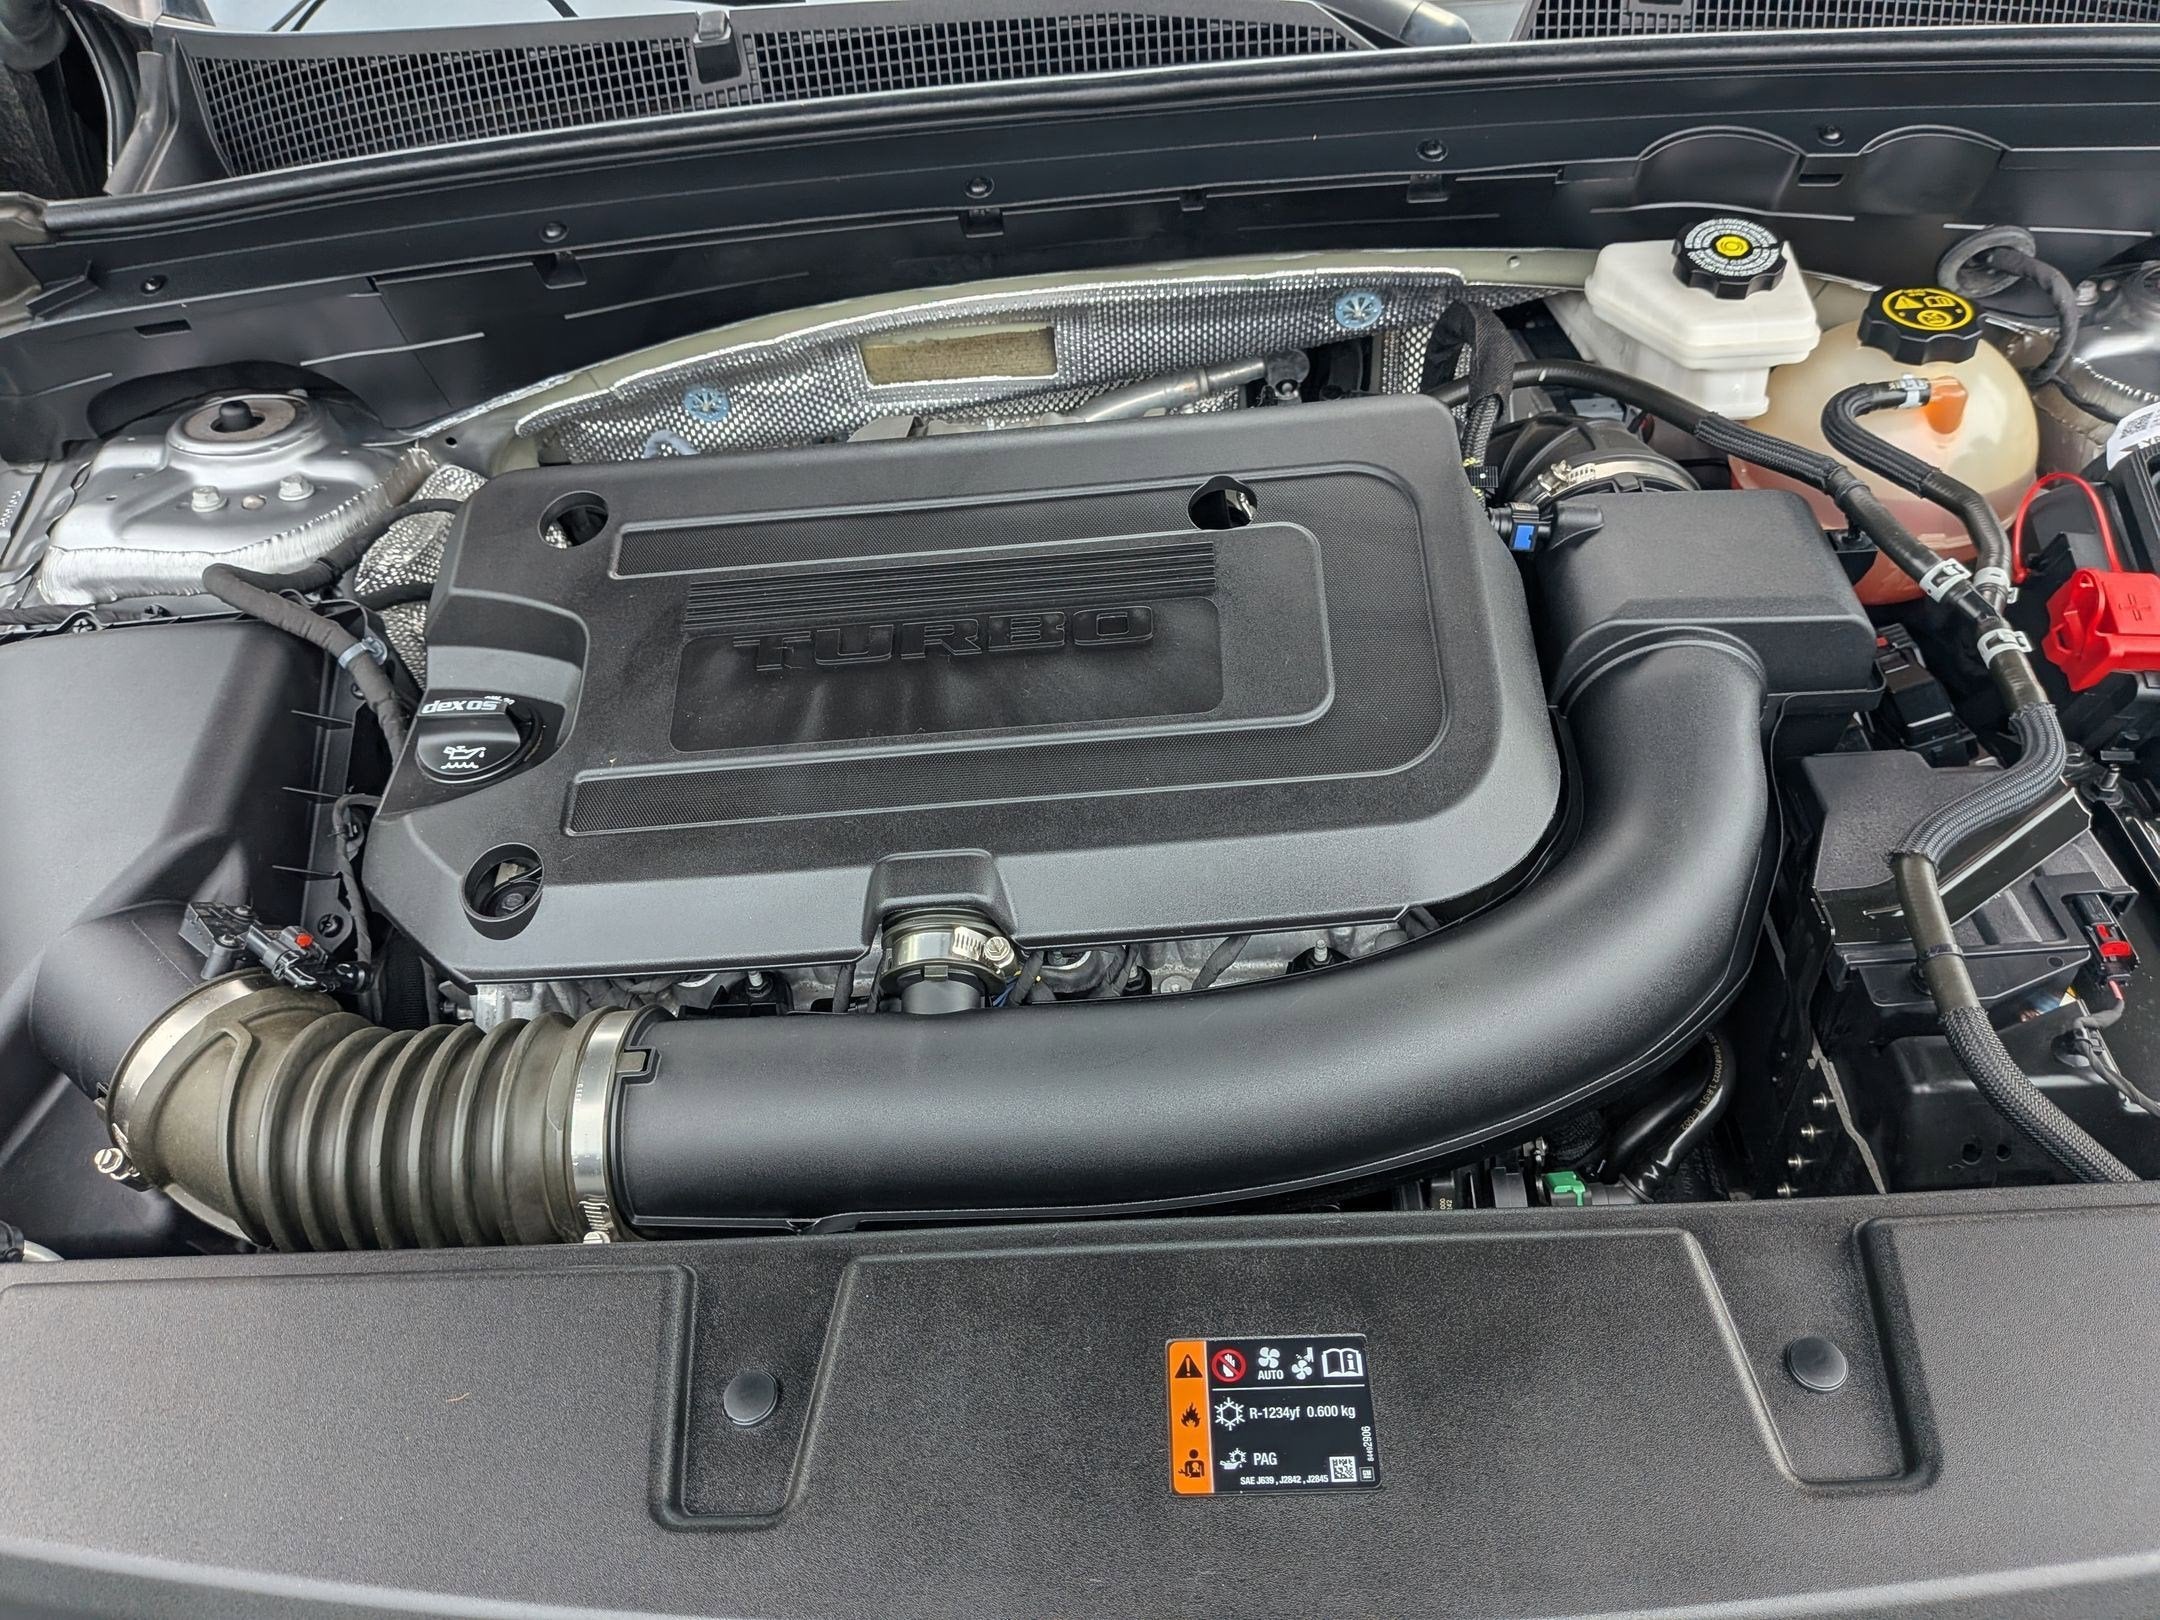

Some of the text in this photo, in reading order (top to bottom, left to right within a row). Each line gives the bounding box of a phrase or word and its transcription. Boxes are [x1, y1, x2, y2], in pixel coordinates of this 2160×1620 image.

[732, 605, 1154, 672] TURBO
[421, 700, 501, 714] dexos
[1257, 1369, 1284, 1380] AUTO
[1249, 1404, 1356, 1421] R-1234yf 0.600 kg
[1253, 1452, 1278, 1466] PAG
[1240, 1476, 1256, 1485] SAE
[1306, 1474, 1329, 1484] J2845
